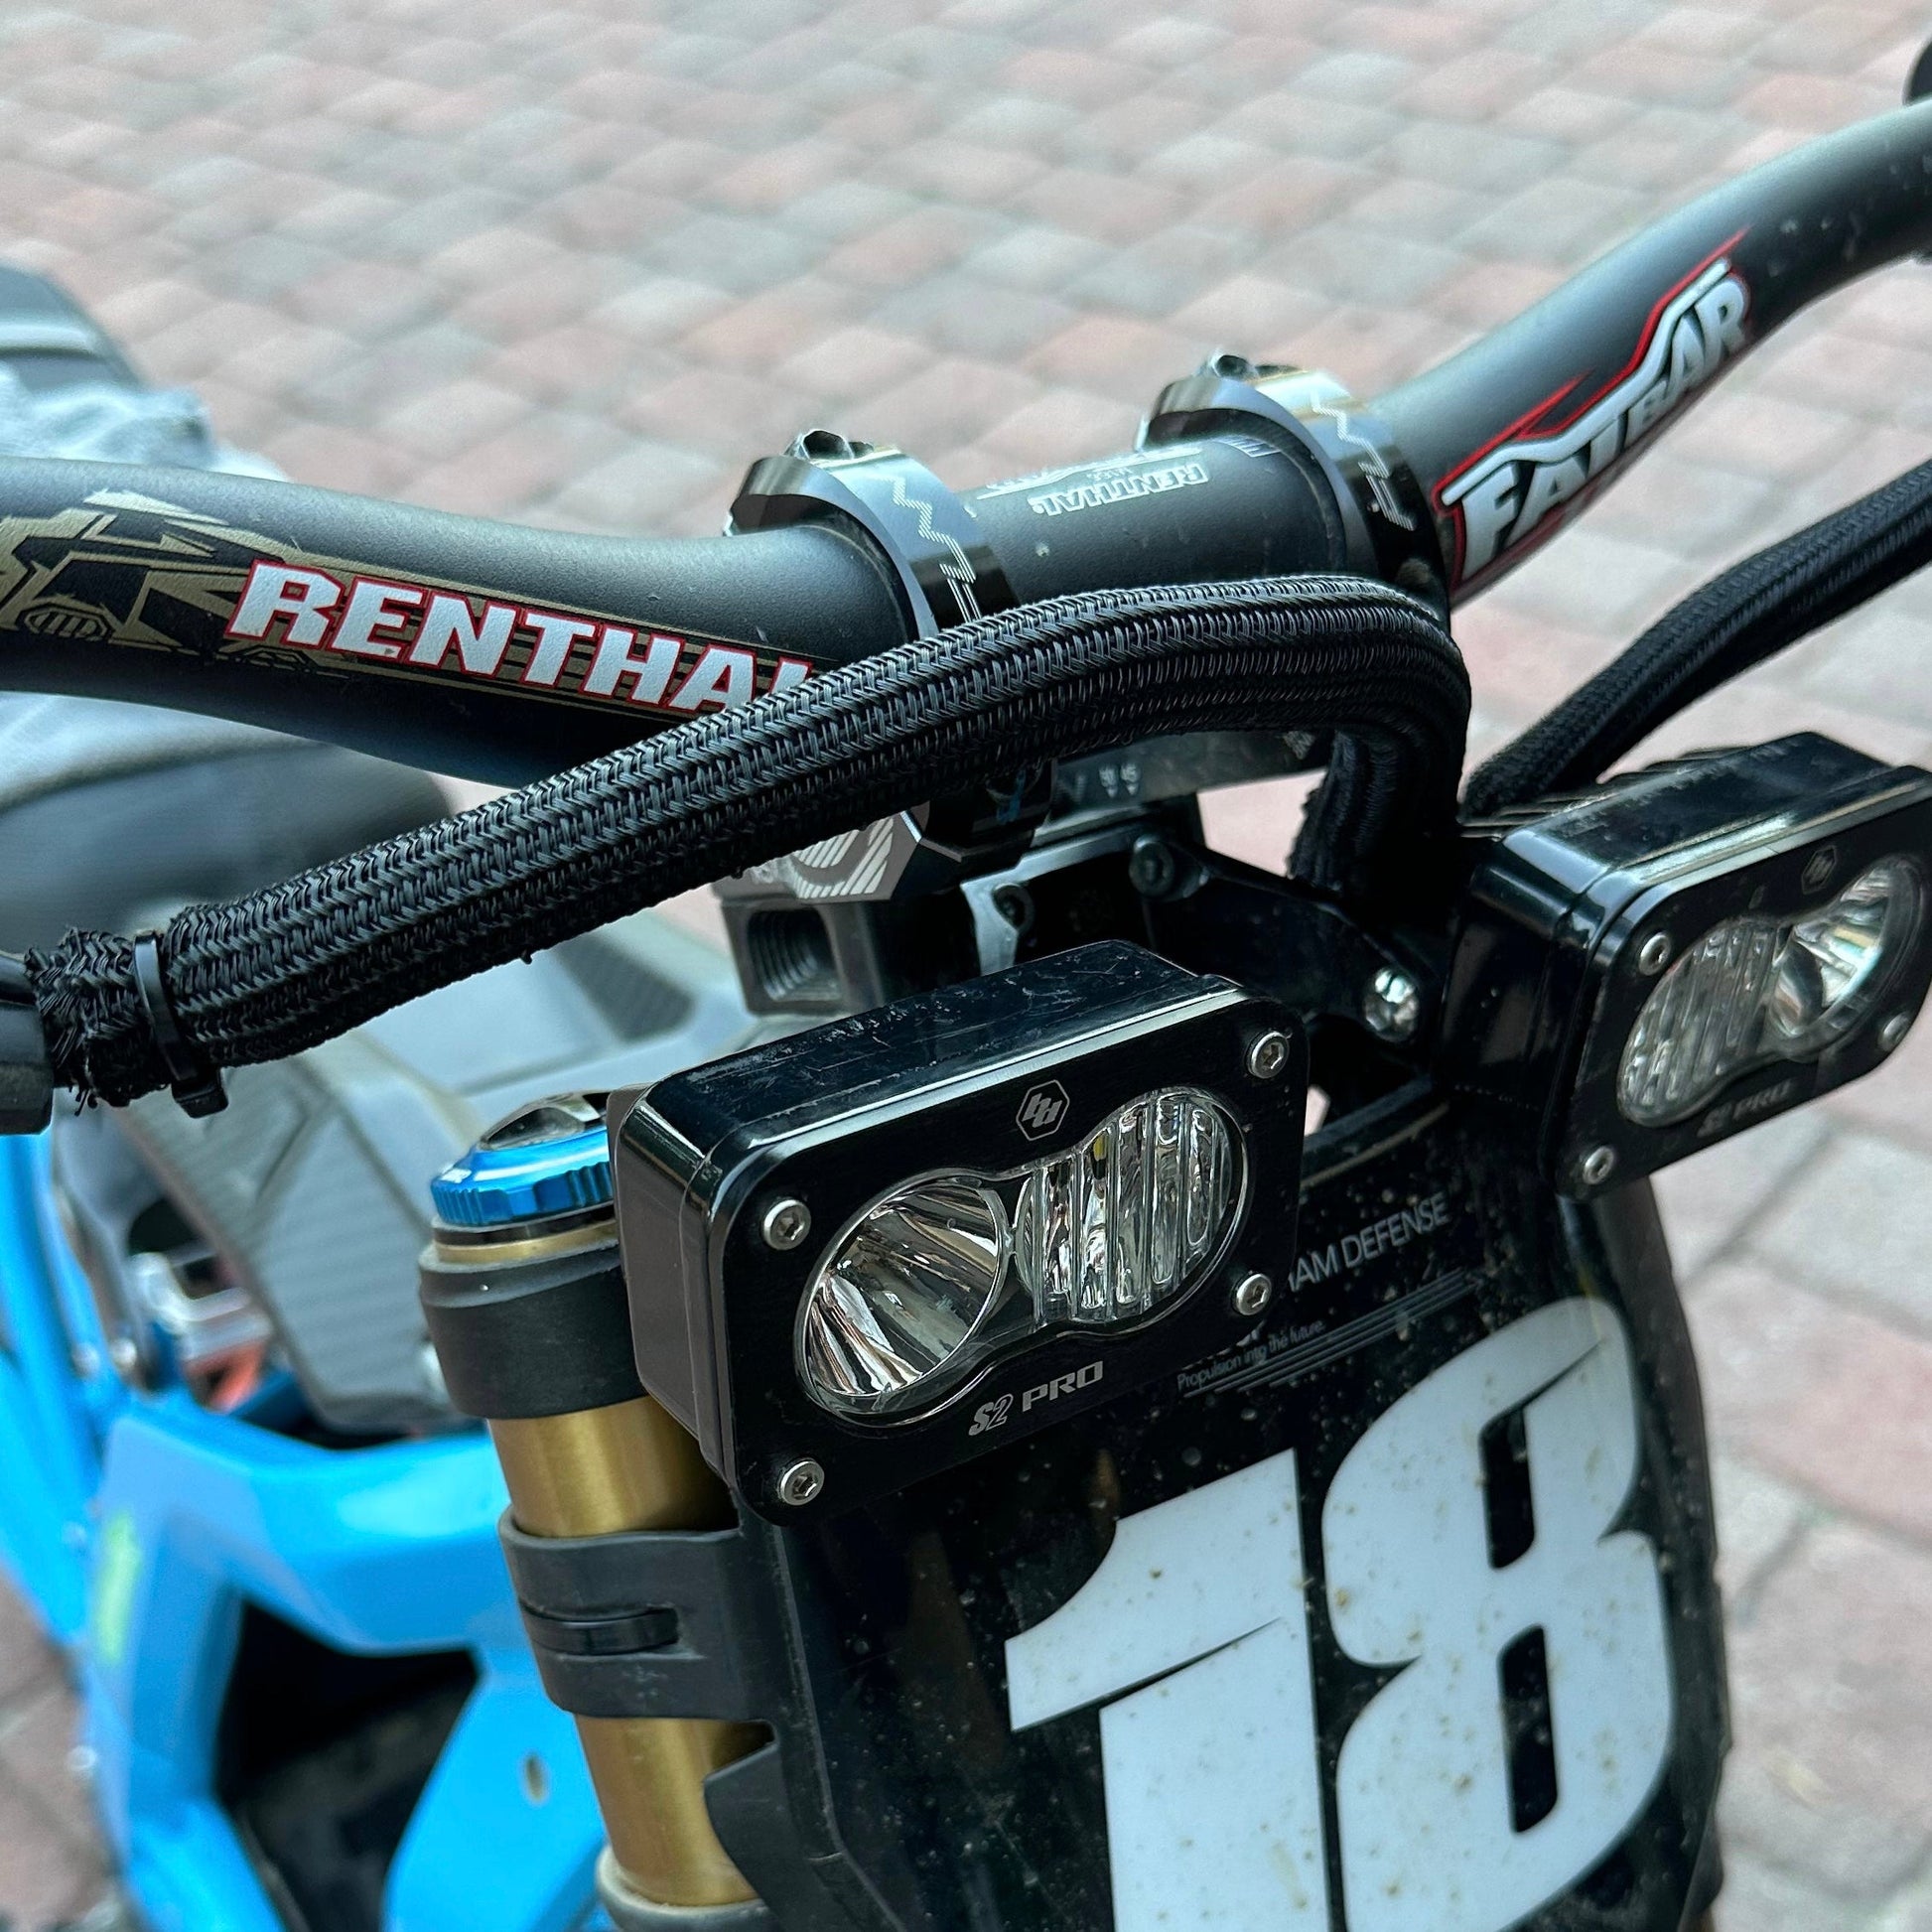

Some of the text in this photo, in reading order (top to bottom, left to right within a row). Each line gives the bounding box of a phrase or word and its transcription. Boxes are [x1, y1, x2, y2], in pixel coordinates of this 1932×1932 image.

[1440, 257, 1751, 584] FATBAR
[1029, 463, 1209, 517] RENTHAL
[1340, 1191, 1450, 1269] DEFENSE
[968, 1360, 1104, 1436] S2 PRO
[1176, 1354, 1242, 1391] Propulsion
[1004, 1296, 1673, 1932] 18
